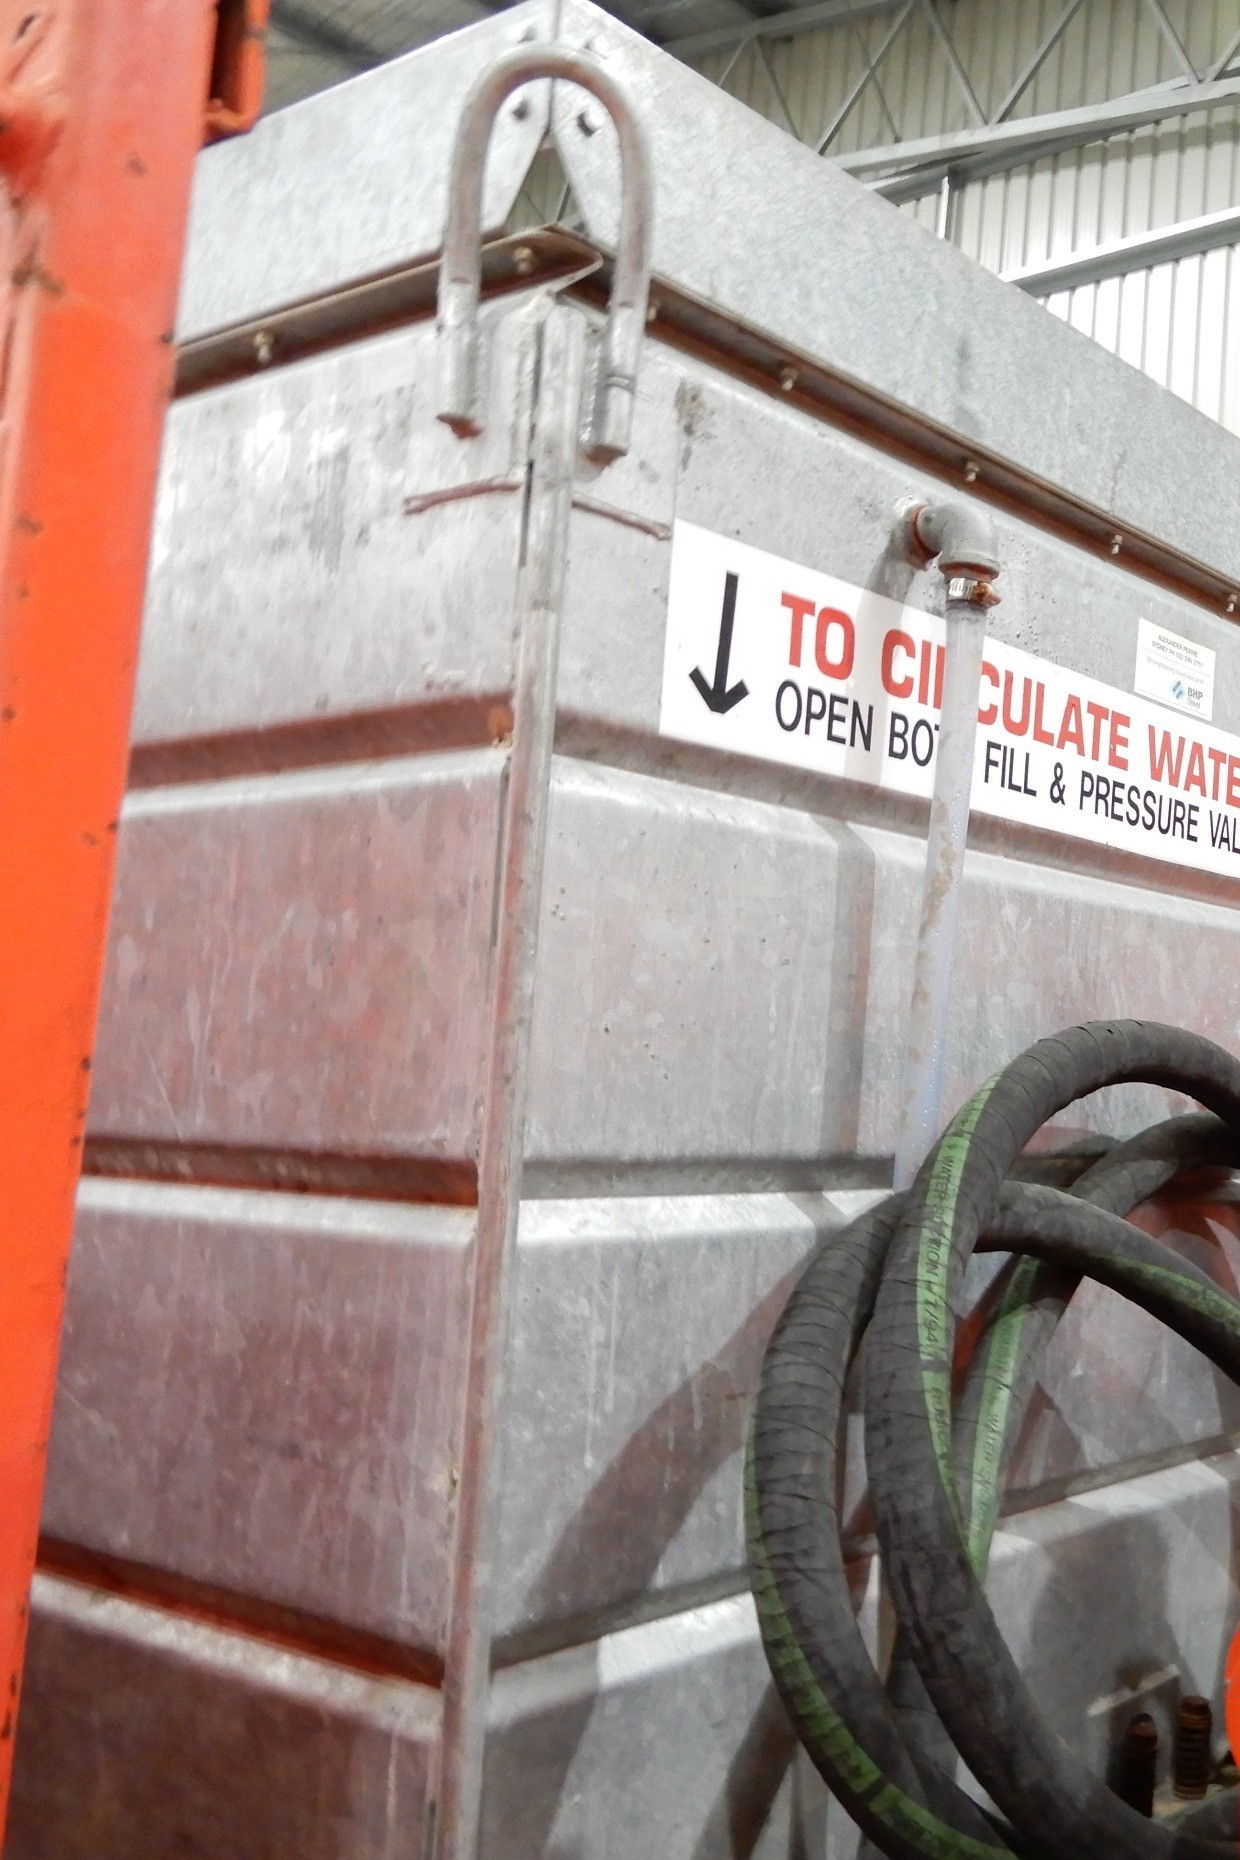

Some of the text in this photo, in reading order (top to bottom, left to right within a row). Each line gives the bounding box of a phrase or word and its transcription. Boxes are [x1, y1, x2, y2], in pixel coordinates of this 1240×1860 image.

[781, 591, 855, 680] TO
[1186, 697, 1201, 709] Steel
[1187, 686, 1203, 701] BHP
[775, 678, 874, 752] OPEN
[888, 710, 940, 767] BO
[984, 740, 1038, 797] FILL
[1049, 762, 1066, 806] &
[1079, 770, 1200, 843] PRESSURE
